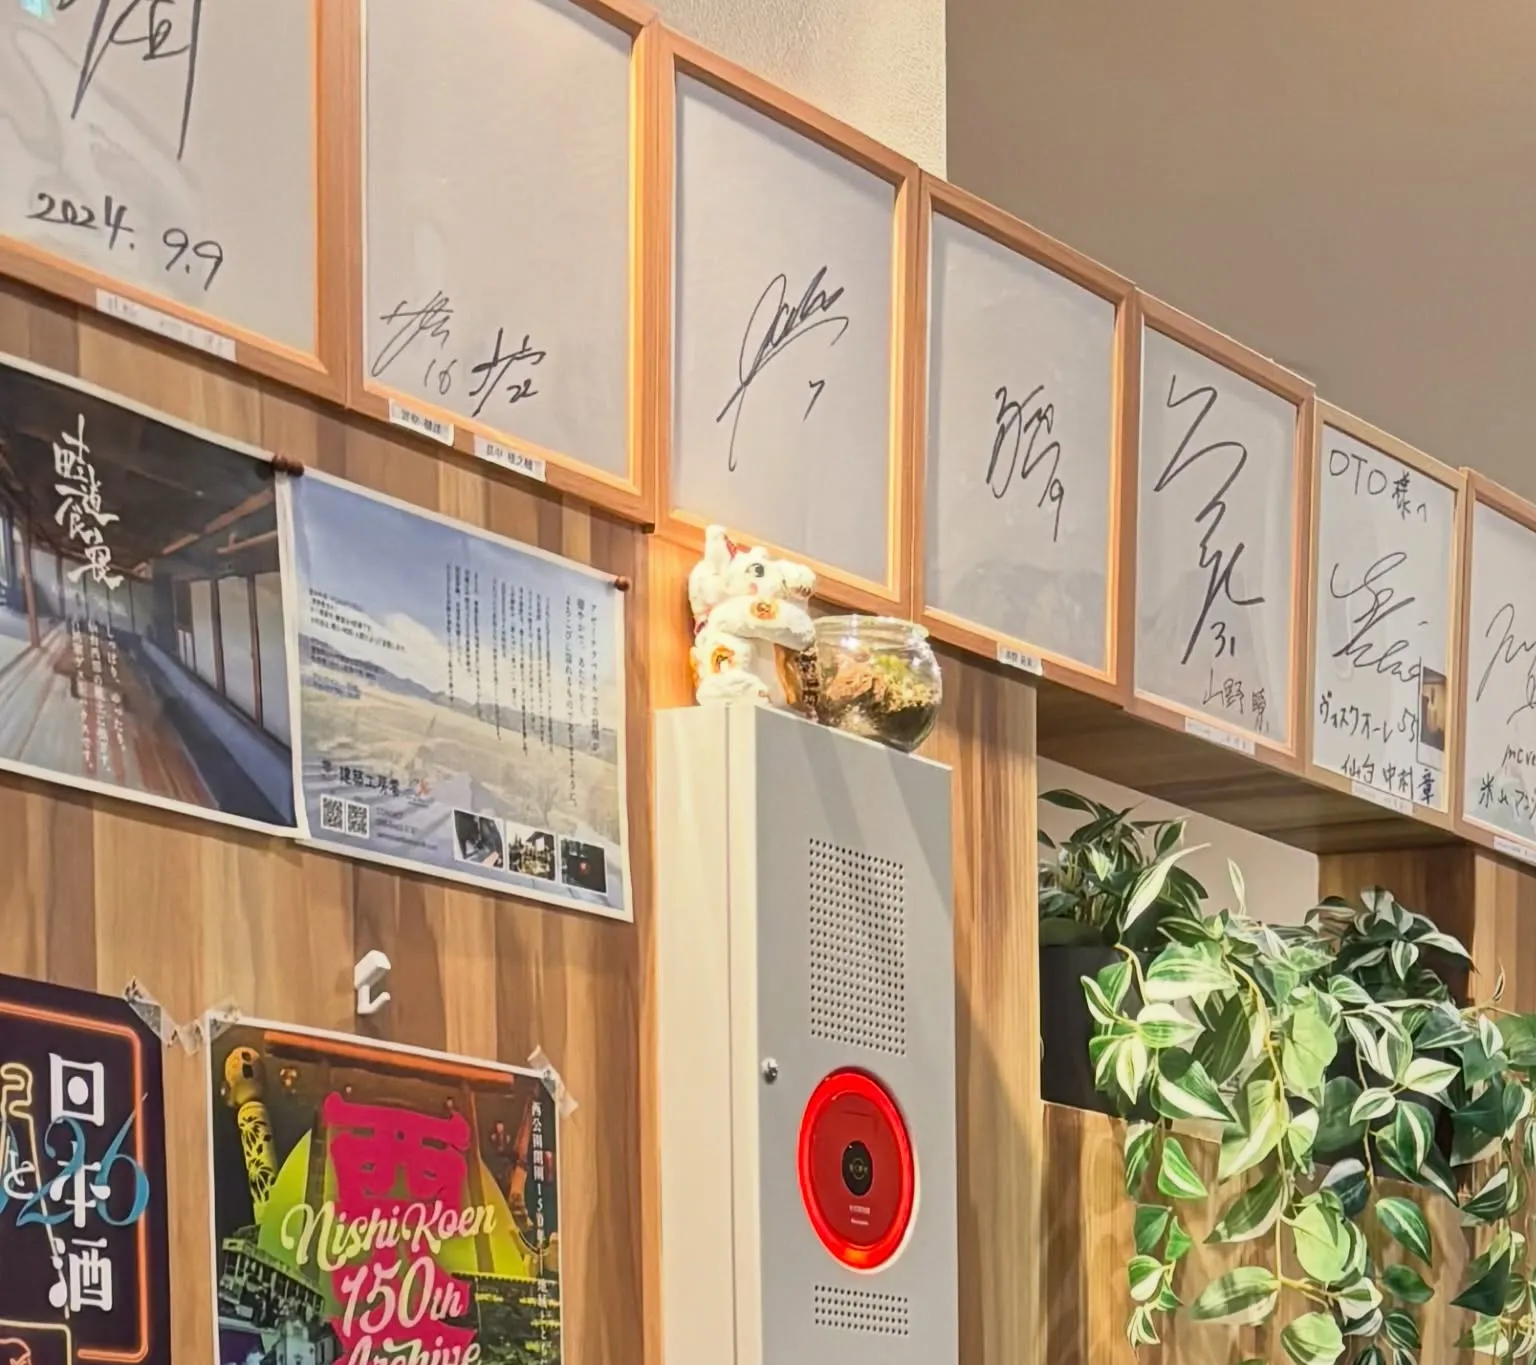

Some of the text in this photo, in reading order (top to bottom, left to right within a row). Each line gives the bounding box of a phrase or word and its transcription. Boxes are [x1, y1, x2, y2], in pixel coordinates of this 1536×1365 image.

[281, 1200, 497, 1271] Nishi Koen
[341, 1256, 463, 1337] 150th
